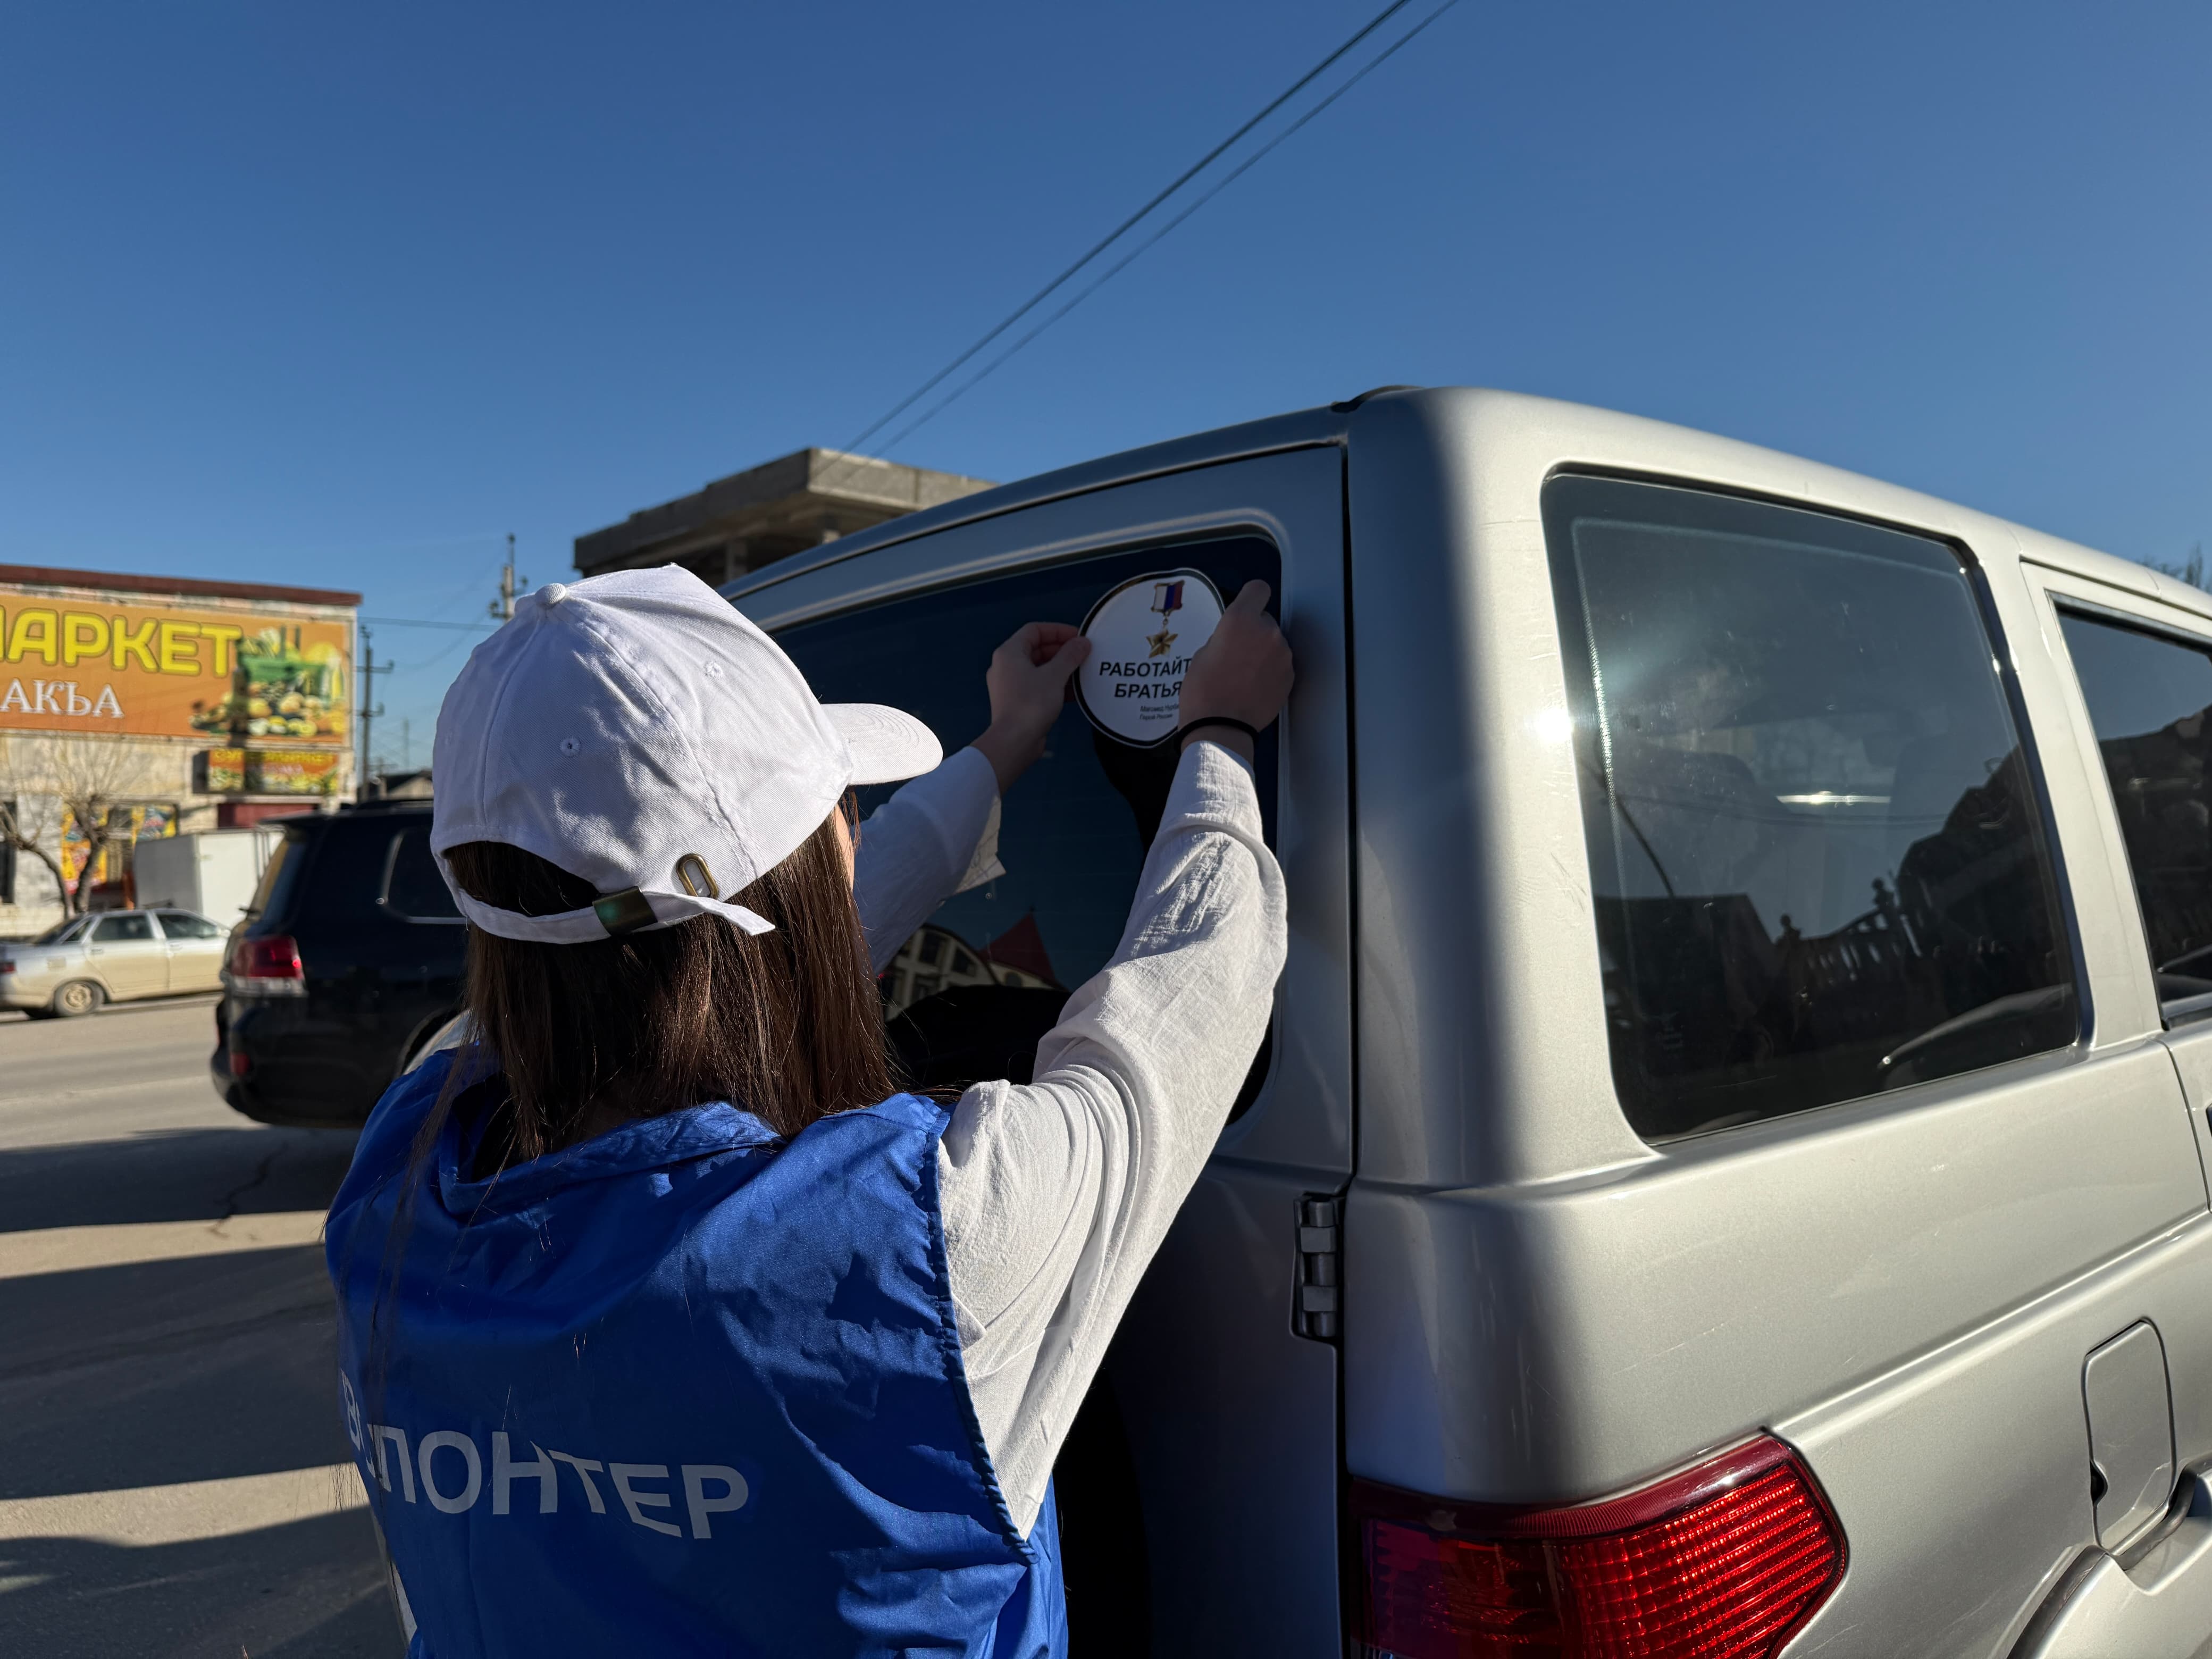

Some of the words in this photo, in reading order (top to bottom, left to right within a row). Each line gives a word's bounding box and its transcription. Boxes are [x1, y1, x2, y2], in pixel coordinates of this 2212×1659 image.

[0, 605, 243, 677] АРКЕТ
[1099, 656, 1192, 677] РАБОТАЙТ
[1115, 681, 1183, 698] БРАТЬЯ
